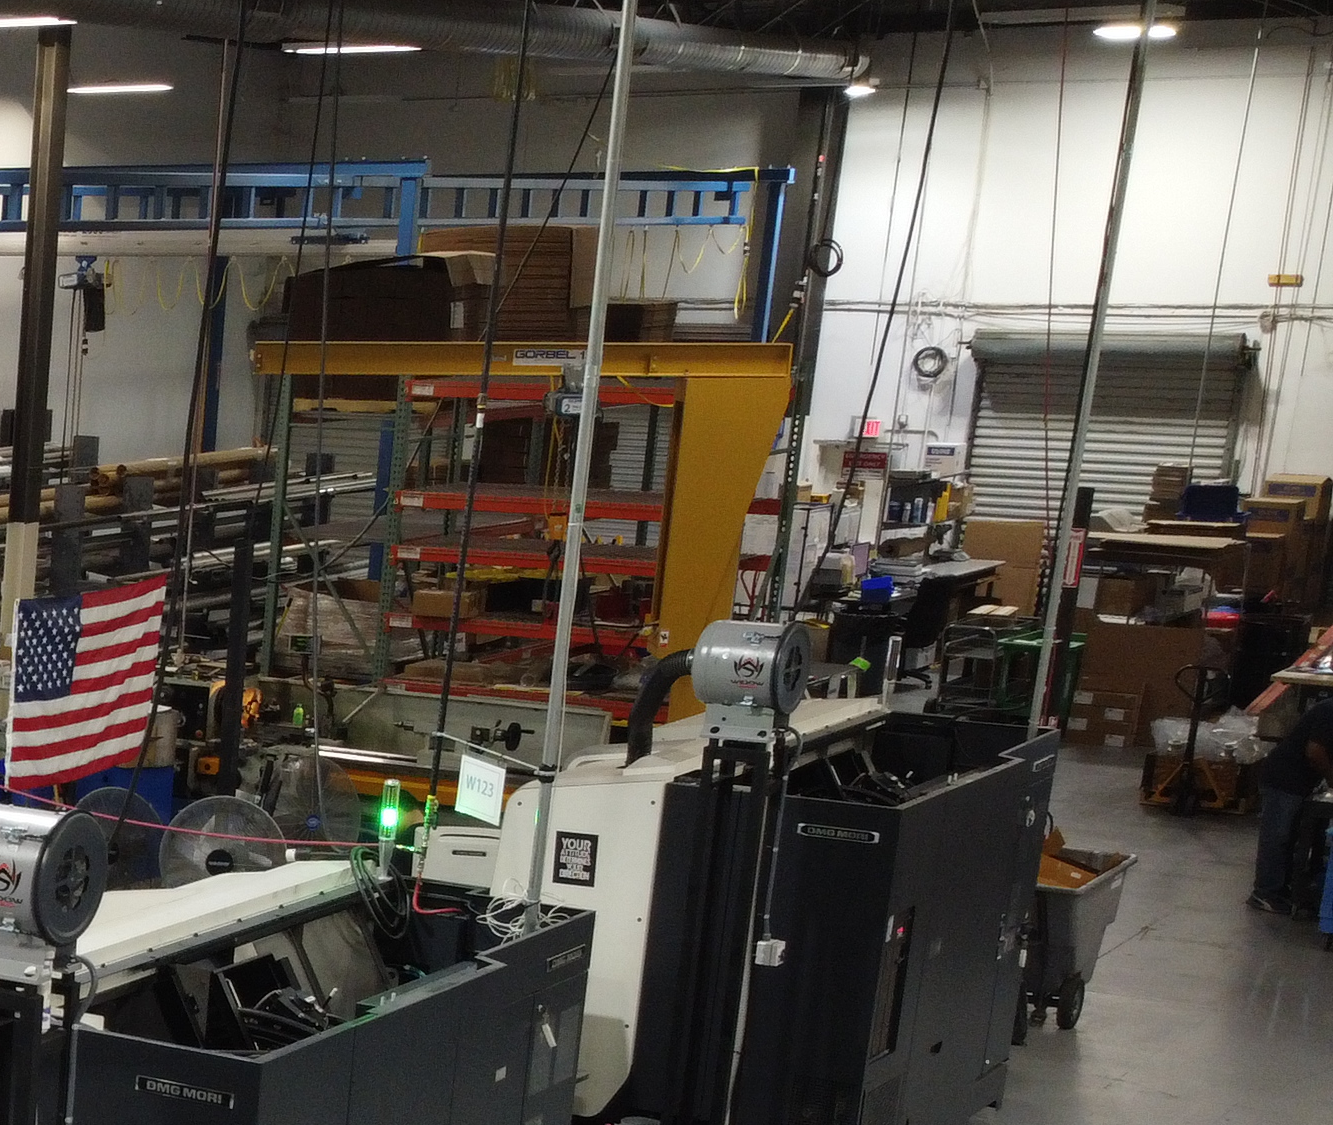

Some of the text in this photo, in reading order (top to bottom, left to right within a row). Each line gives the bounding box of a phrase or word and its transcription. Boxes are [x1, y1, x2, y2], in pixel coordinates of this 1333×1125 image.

[515, 349, 577, 360] GORBEL
[466, 774, 494, 797] W123
[807, 826, 836, 837] DMG
[561, 837, 592, 854] YOUR
[146, 1080, 223, 1105] DMG MORI
